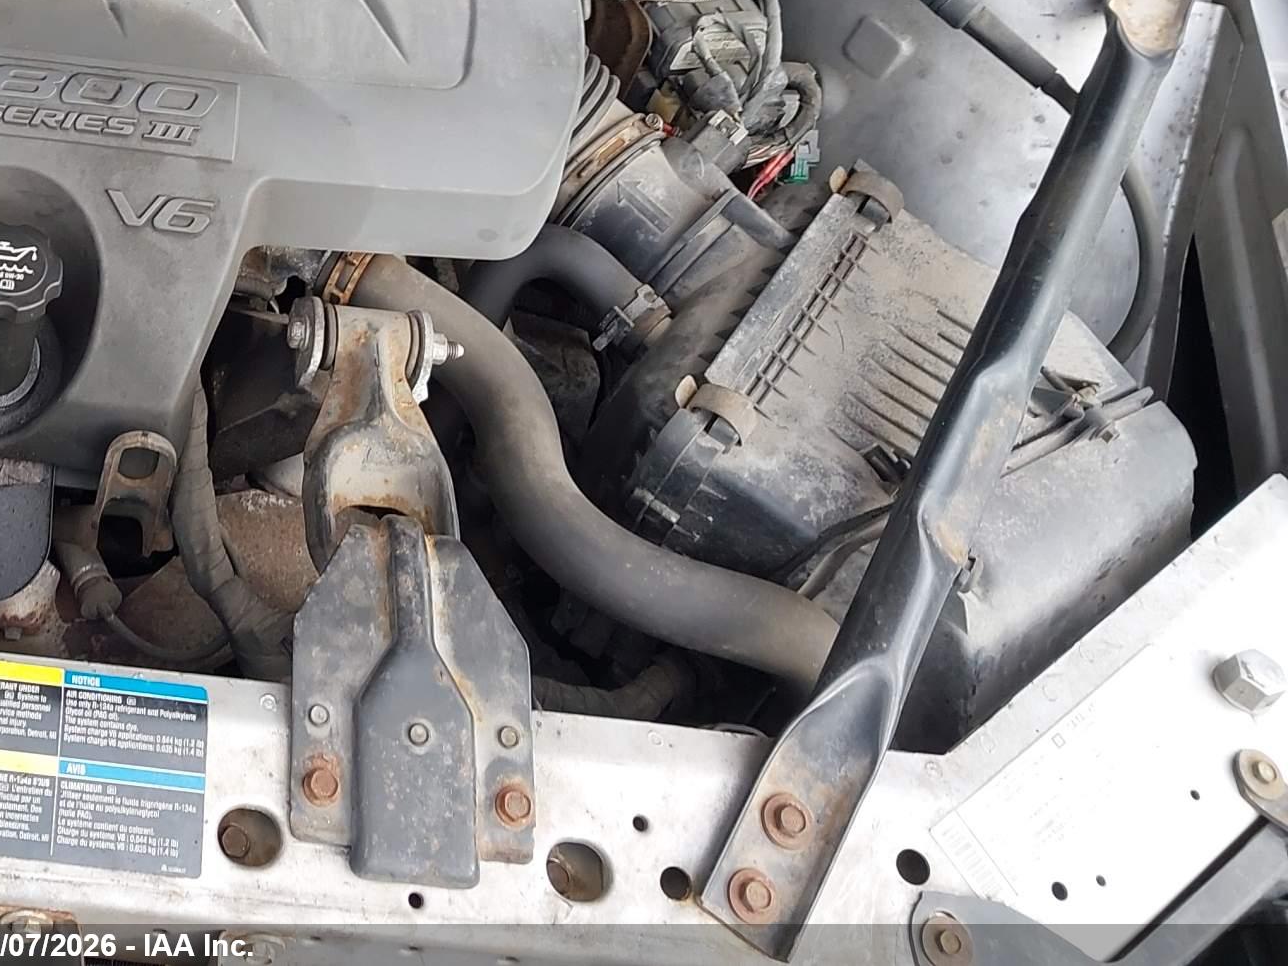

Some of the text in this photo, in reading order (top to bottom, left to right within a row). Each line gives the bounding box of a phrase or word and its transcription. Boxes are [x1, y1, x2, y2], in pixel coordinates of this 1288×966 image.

[142, 120, 200, 146] III
[106, 188, 216, 234] V6
[71, 675, 101, 687] NOTICE
